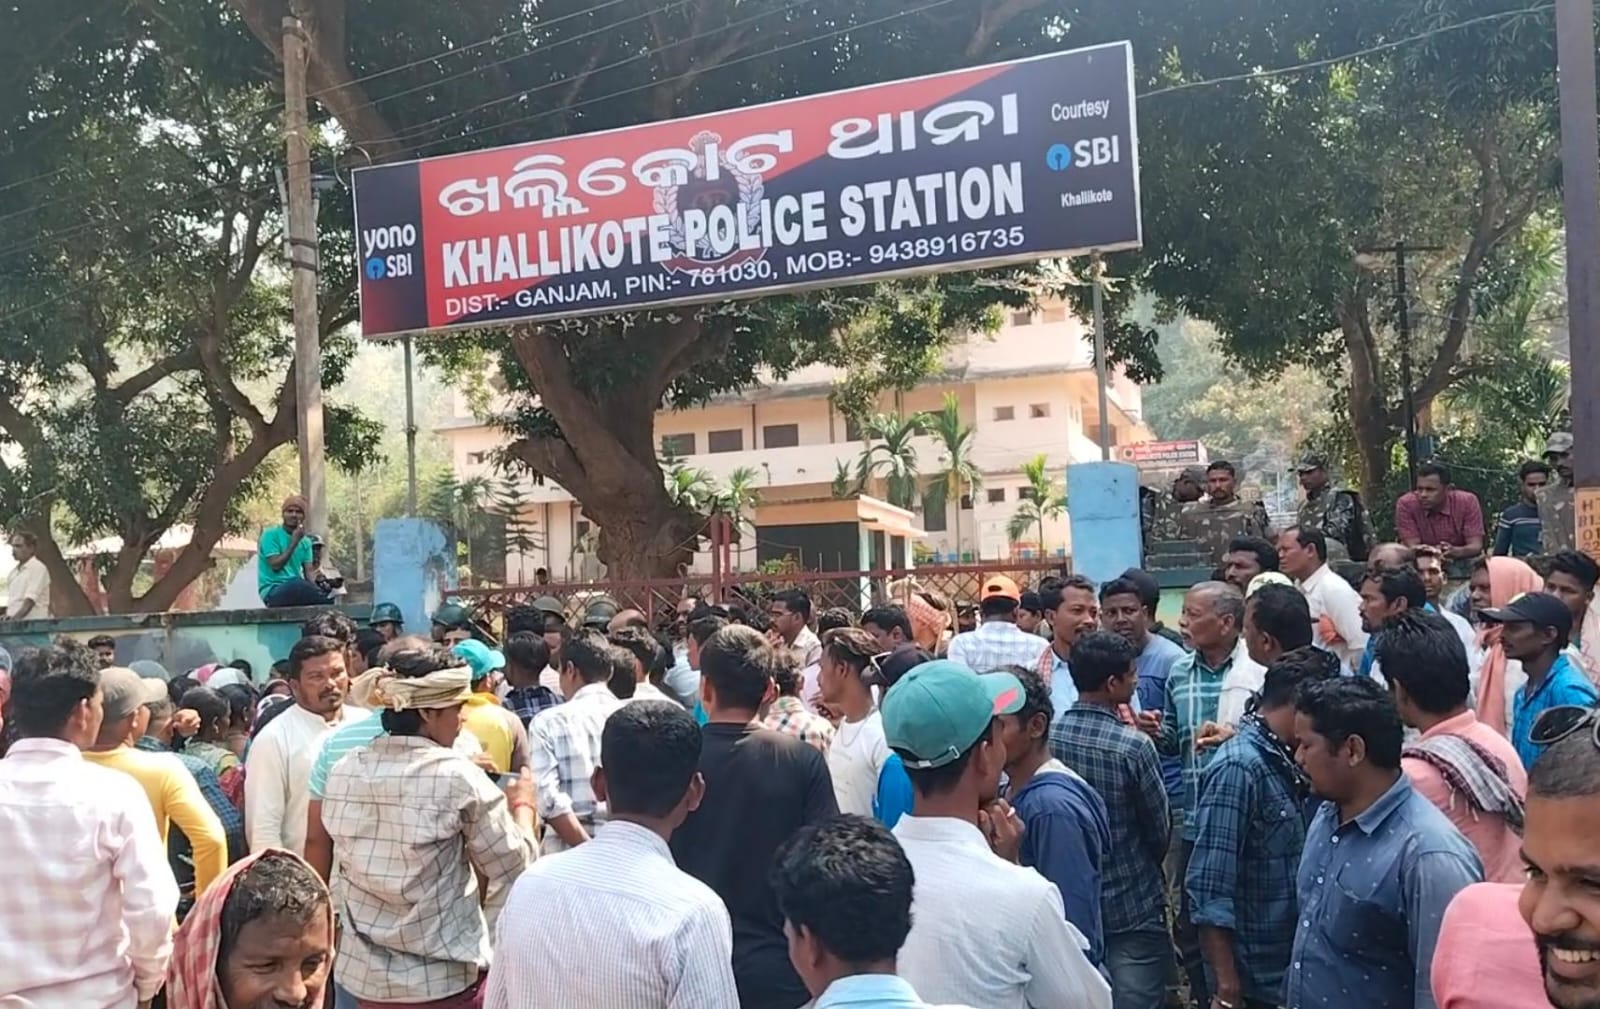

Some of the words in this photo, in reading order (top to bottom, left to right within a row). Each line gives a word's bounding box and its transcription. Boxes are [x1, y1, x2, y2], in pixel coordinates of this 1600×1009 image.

[827, 93, 1019, 160] ଥାନା
[1051, 99, 1110, 121] Courtesy
[1074, 135, 1119, 168] SBI
[1061, 188, 1113, 208] Khallikote
[363, 223, 416, 258] yono
[442, 214, 672, 288] KHALLIKOTE
[683, 190, 828, 258] POLICE
[840, 161, 1024, 237] STATION
[386, 253, 413, 278] SBI
[445, 293, 509, 316] DIST:-
[515, 280, 617, 308] GANJAM,
[625, 273, 681, 295] PIN:-
[689, 260, 778, 287] 761030,
[786, 250, 862, 275] MOB:-
[869, 226, 1025, 264] 9438916735
